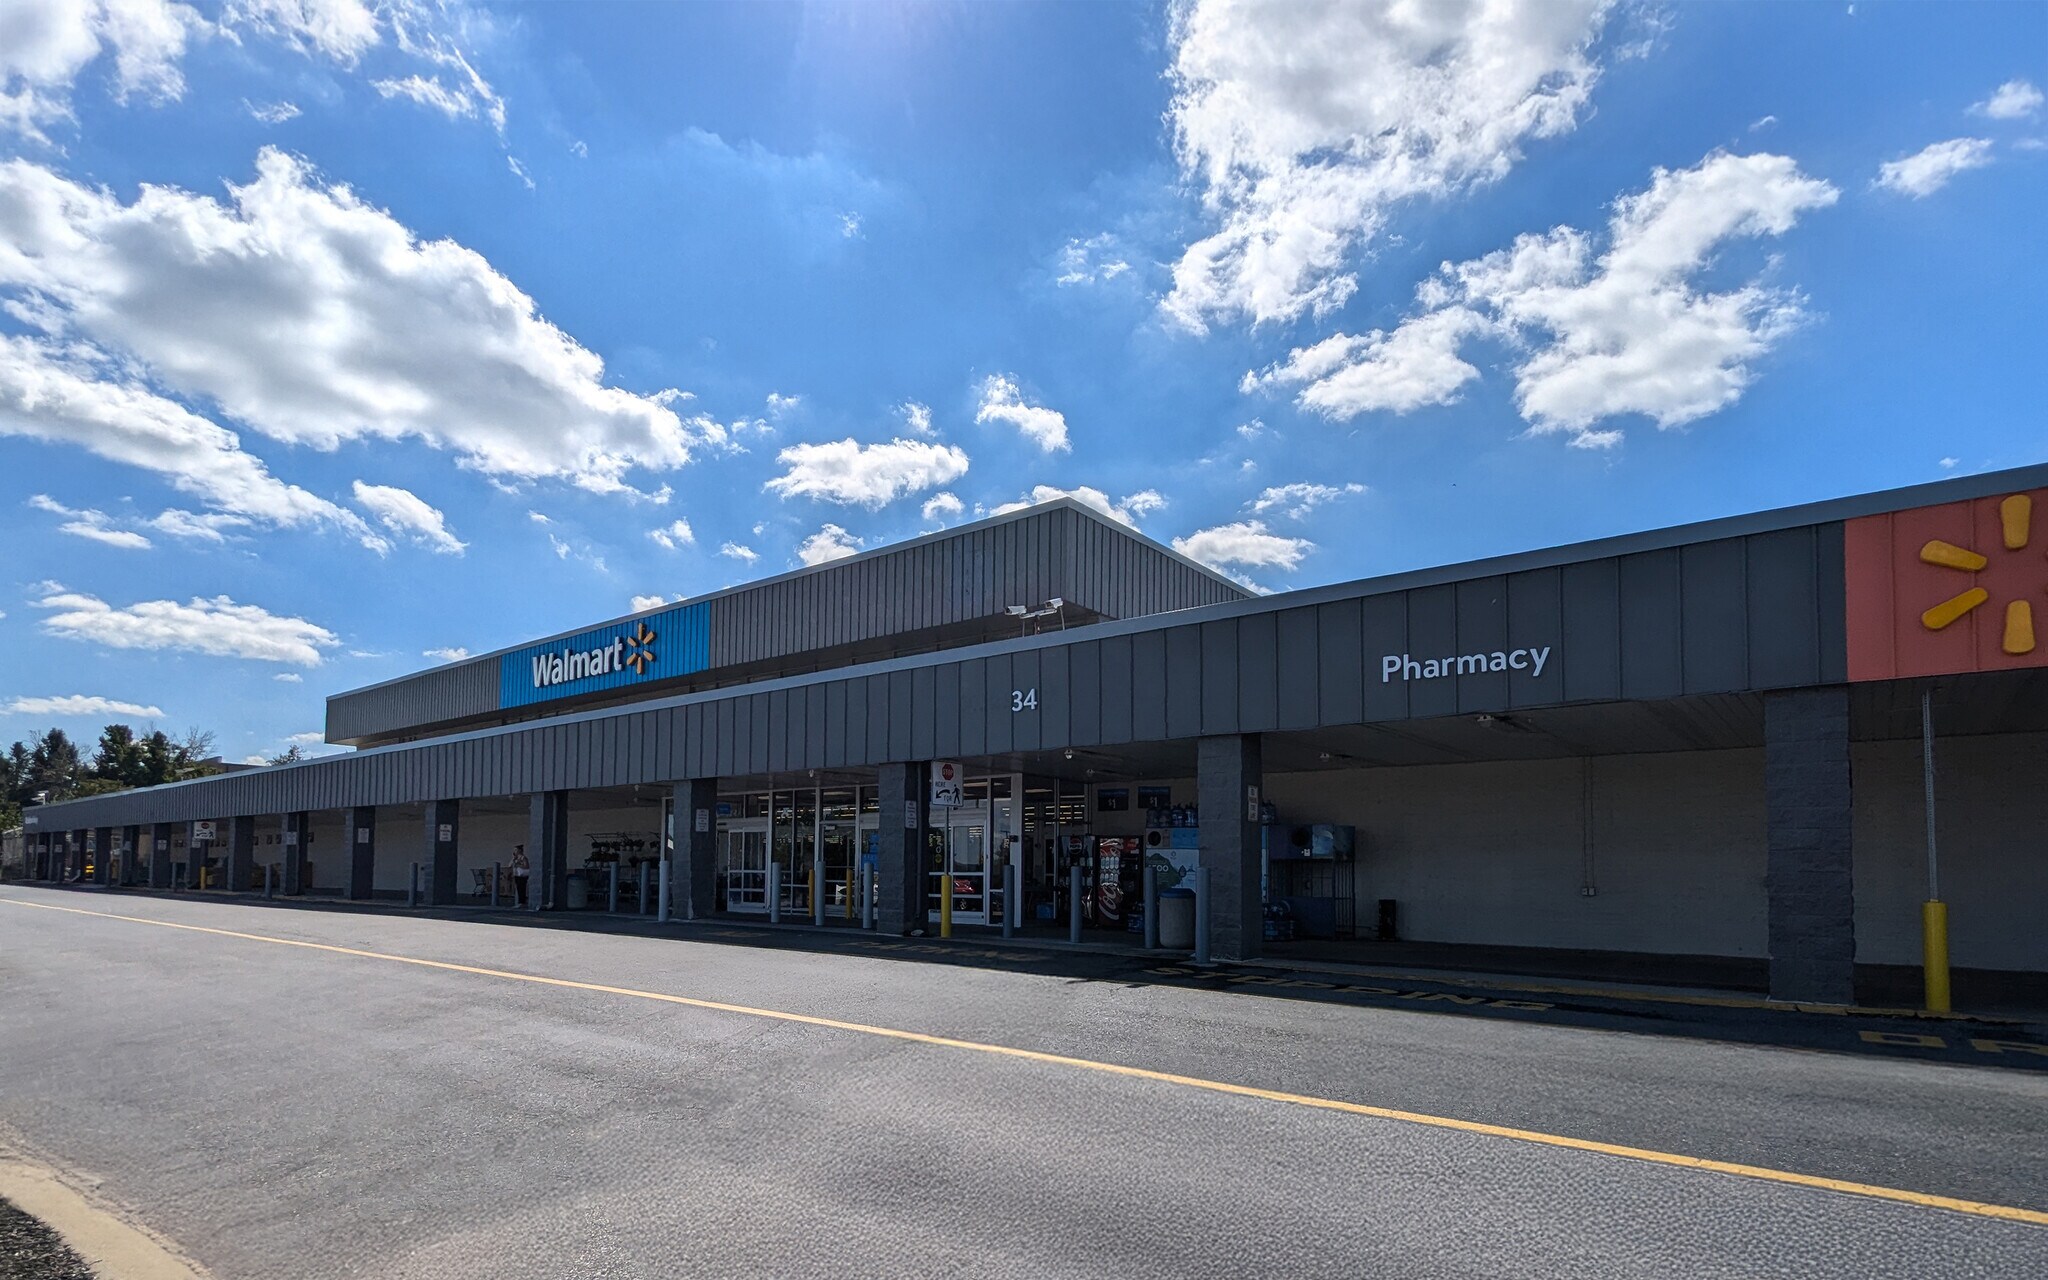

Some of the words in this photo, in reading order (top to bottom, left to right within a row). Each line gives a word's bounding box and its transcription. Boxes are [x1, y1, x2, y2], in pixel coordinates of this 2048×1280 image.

[532, 636, 623, 688] Walmart
[1382, 646, 1551, 683] Pharmacy
[1011, 688, 1038, 712] 34
[943, 768, 954, 776] STOP
[1141, 967, 1555, 1012] STOPPING
